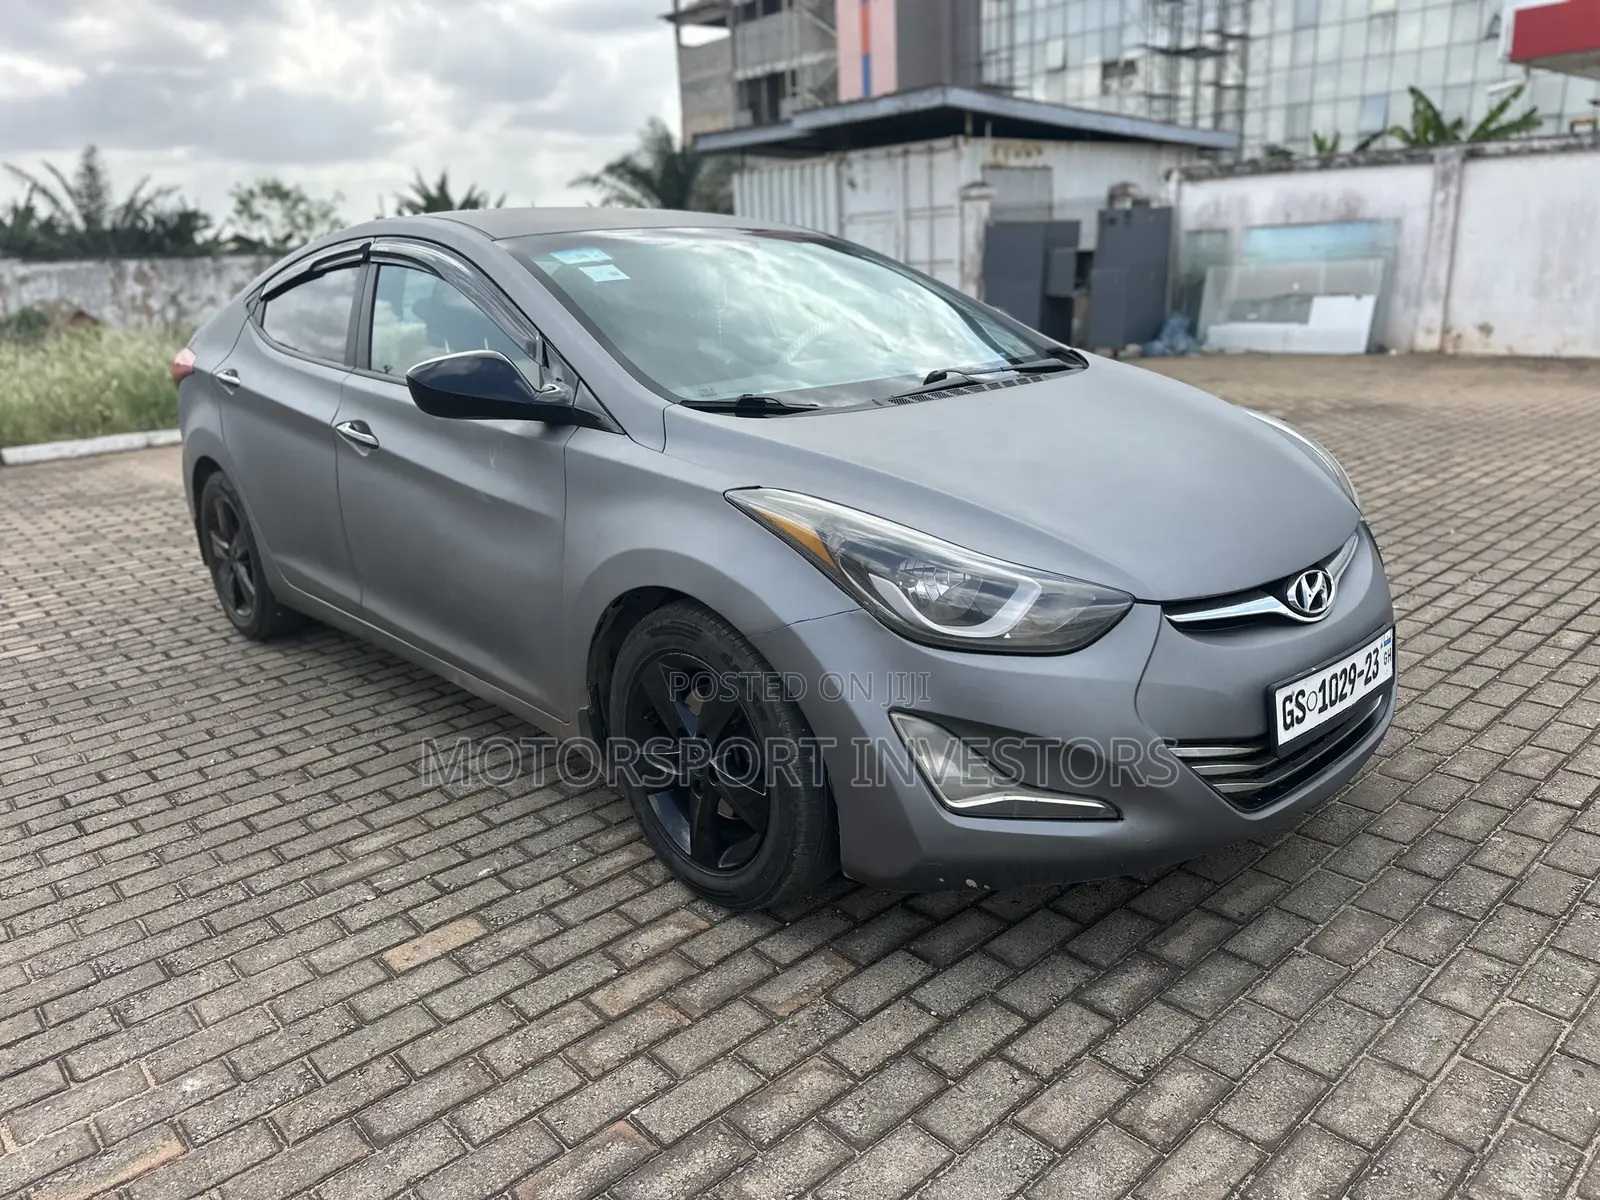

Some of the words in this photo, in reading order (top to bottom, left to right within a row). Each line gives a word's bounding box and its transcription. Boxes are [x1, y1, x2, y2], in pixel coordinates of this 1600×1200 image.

[1383, 647, 1392, 666] GH
[1282, 688, 1307, 731] GS
[1317, 647, 1380, 714] 1029-23
